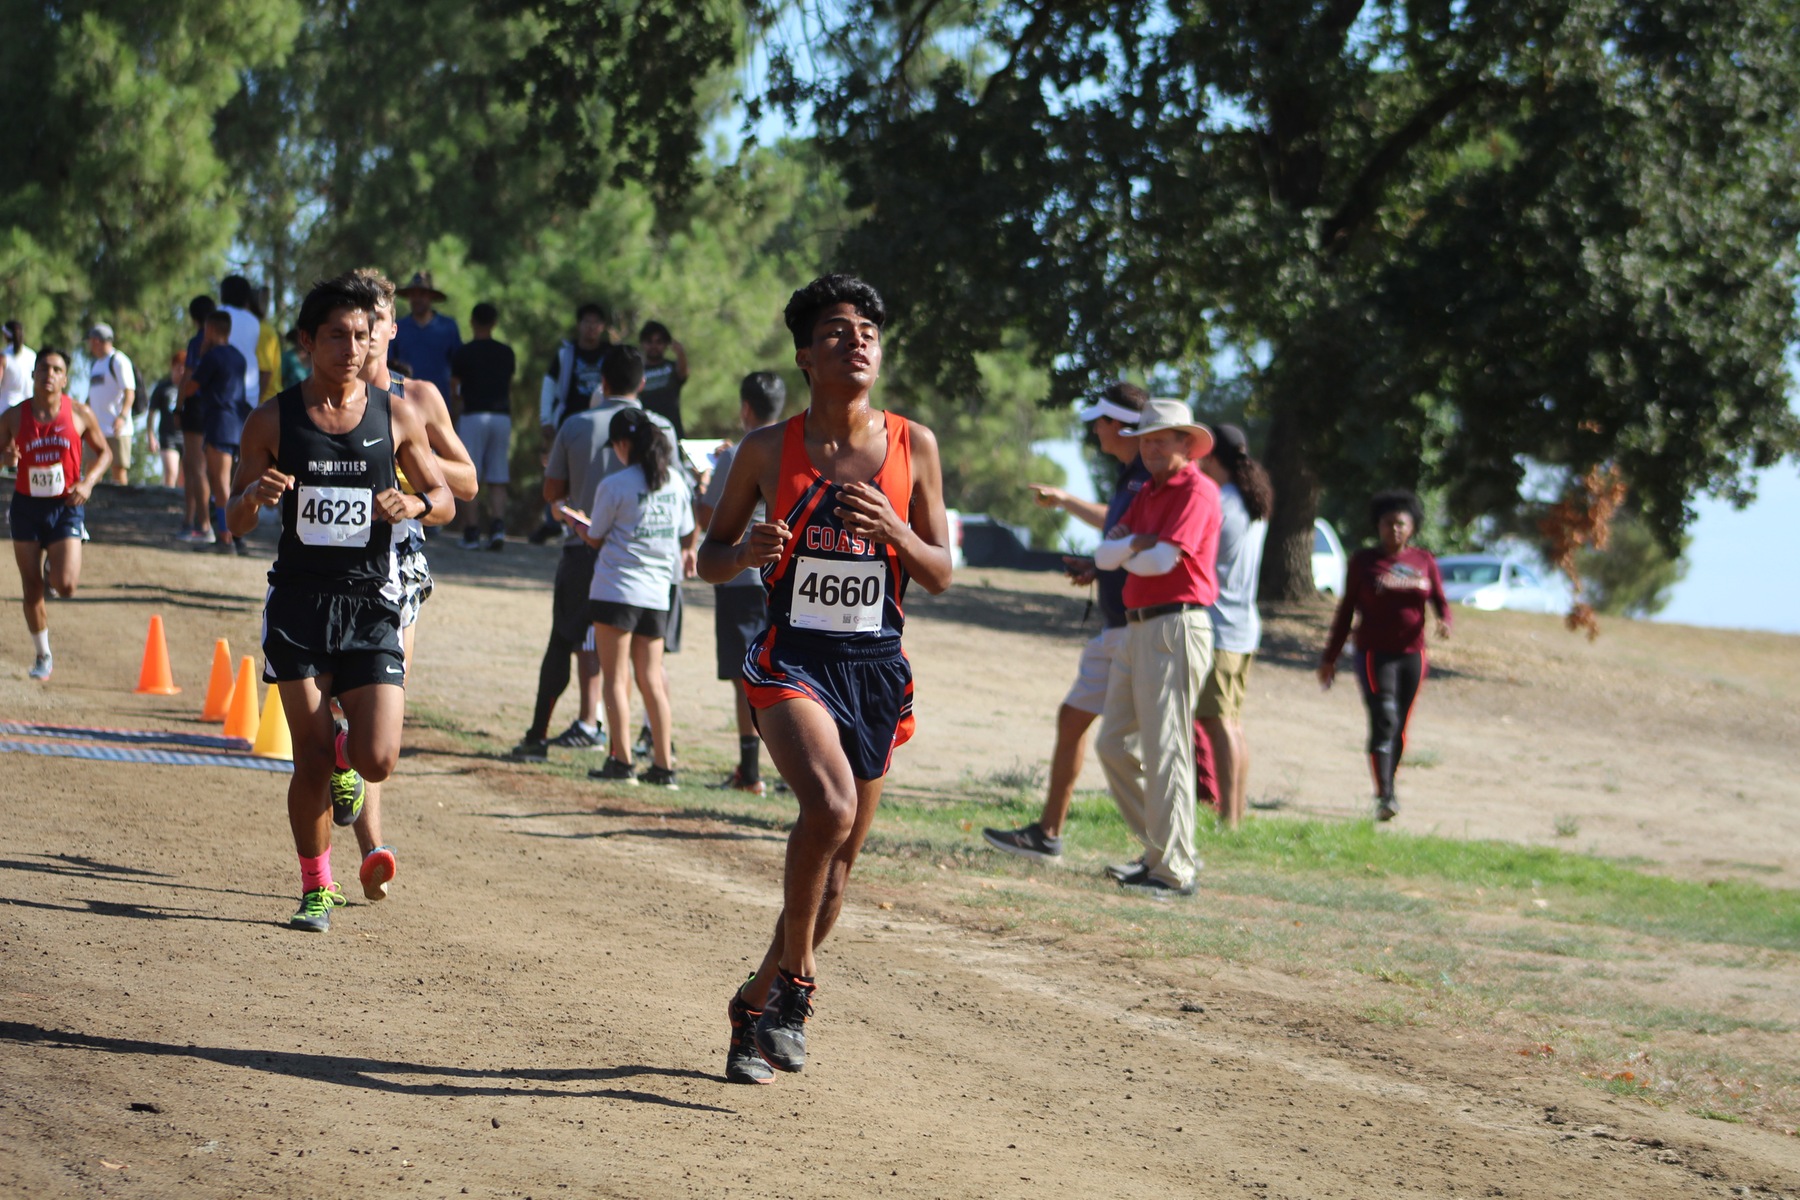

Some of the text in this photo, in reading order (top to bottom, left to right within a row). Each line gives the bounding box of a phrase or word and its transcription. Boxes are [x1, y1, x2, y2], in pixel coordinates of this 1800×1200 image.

[26, 435, 71, 453] AMERICAN
[35, 451, 60, 463] RIVER
[31, 471, 62, 487] 4374
[301, 498, 367, 526] 4623
[798, 572, 880, 607] 4660
